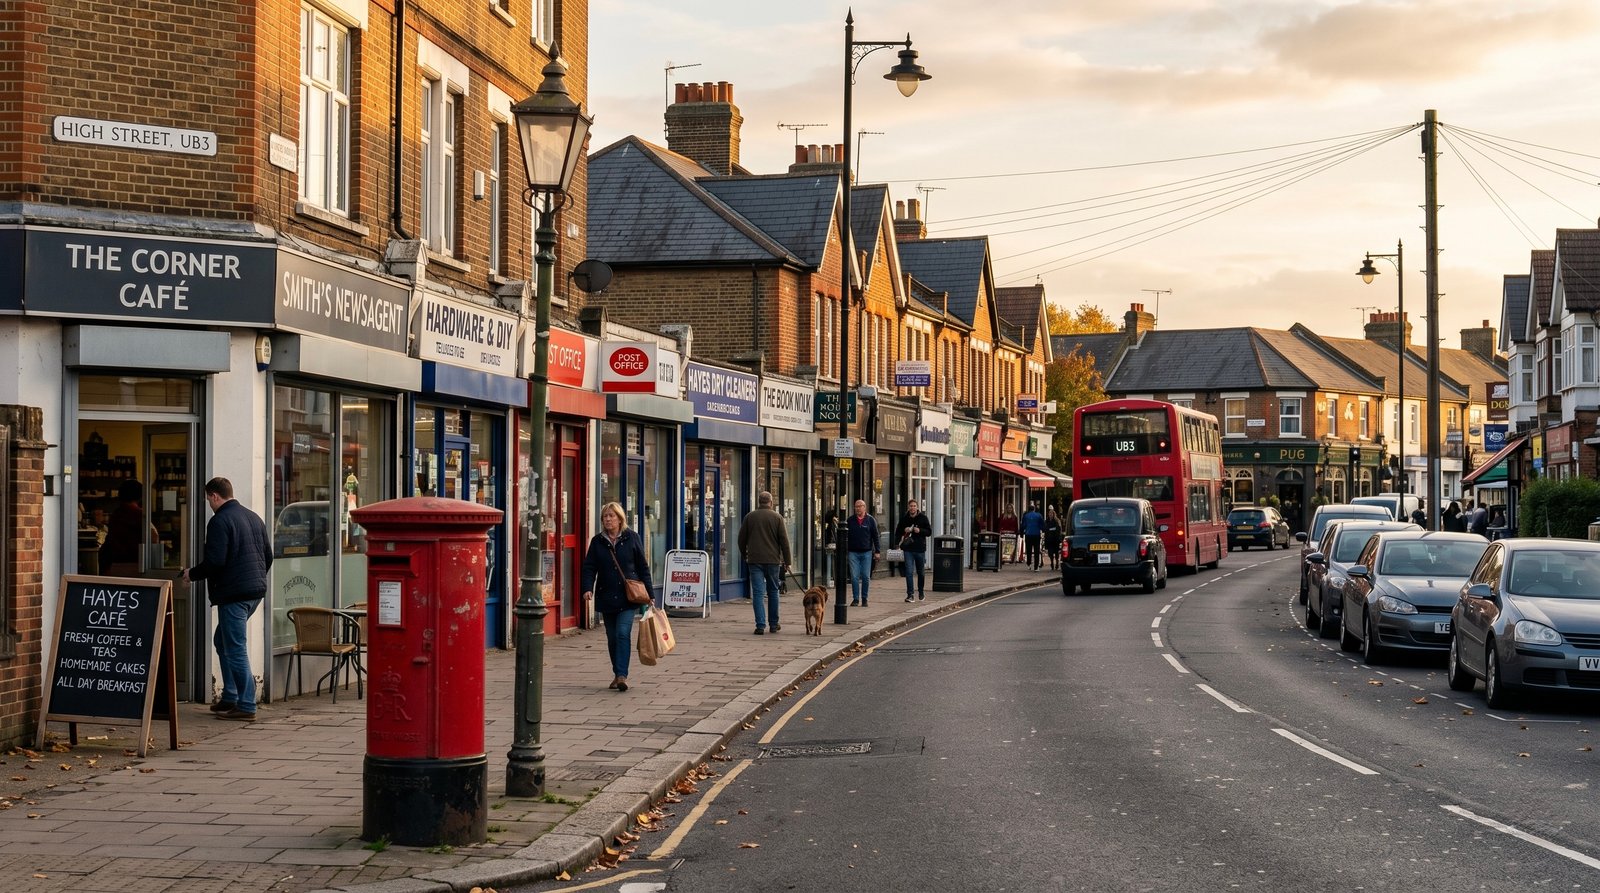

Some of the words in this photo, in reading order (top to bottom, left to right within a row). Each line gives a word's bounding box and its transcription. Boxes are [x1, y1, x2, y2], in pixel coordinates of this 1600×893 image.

[61, 121, 103, 140] HIGH
[112, 127, 173, 149] STREET,
[181, 134, 210, 151] UB3
[66, 243, 122, 272] THE
[131, 249, 241, 279] CORNER
[119, 281, 190, 311] CAFÉ
[282, 271, 332, 318] SMITH'S
[335, 287, 404, 336] NEWSAGENT
[425, 301, 485, 344] HARDWARE
[486, 321, 495, 346] &
[496, 323, 514, 351] DIY
[559, 347, 582, 371] OFFICE
[613, 361, 644, 370] OFFICE
[618, 353, 641, 362] POST
[688, 368, 711, 395] HAYES
[711, 372, 725, 397] DRY
[763, 386, 775, 408] THE
[776, 389, 795, 411] BOOK
[1115, 440, 1135, 452] UB3
[1279, 449, 1305, 460] PUG
[82, 588, 140, 609] HAYES
[88, 609, 128, 627] CAFÉ
[64, 631, 94, 644] FRESH
[97, 634, 132, 647] COFFEE
[135, 637, 143, 647] &
[92, 647, 117, 658] TEAS
[60, 658, 111, 672] HOMEMADE
[115, 662, 146, 675] CAKES
[56, 676, 75, 688] ALL
[77, 677, 96, 690] DAY
[97, 679, 147, 694] BREAKFAST
